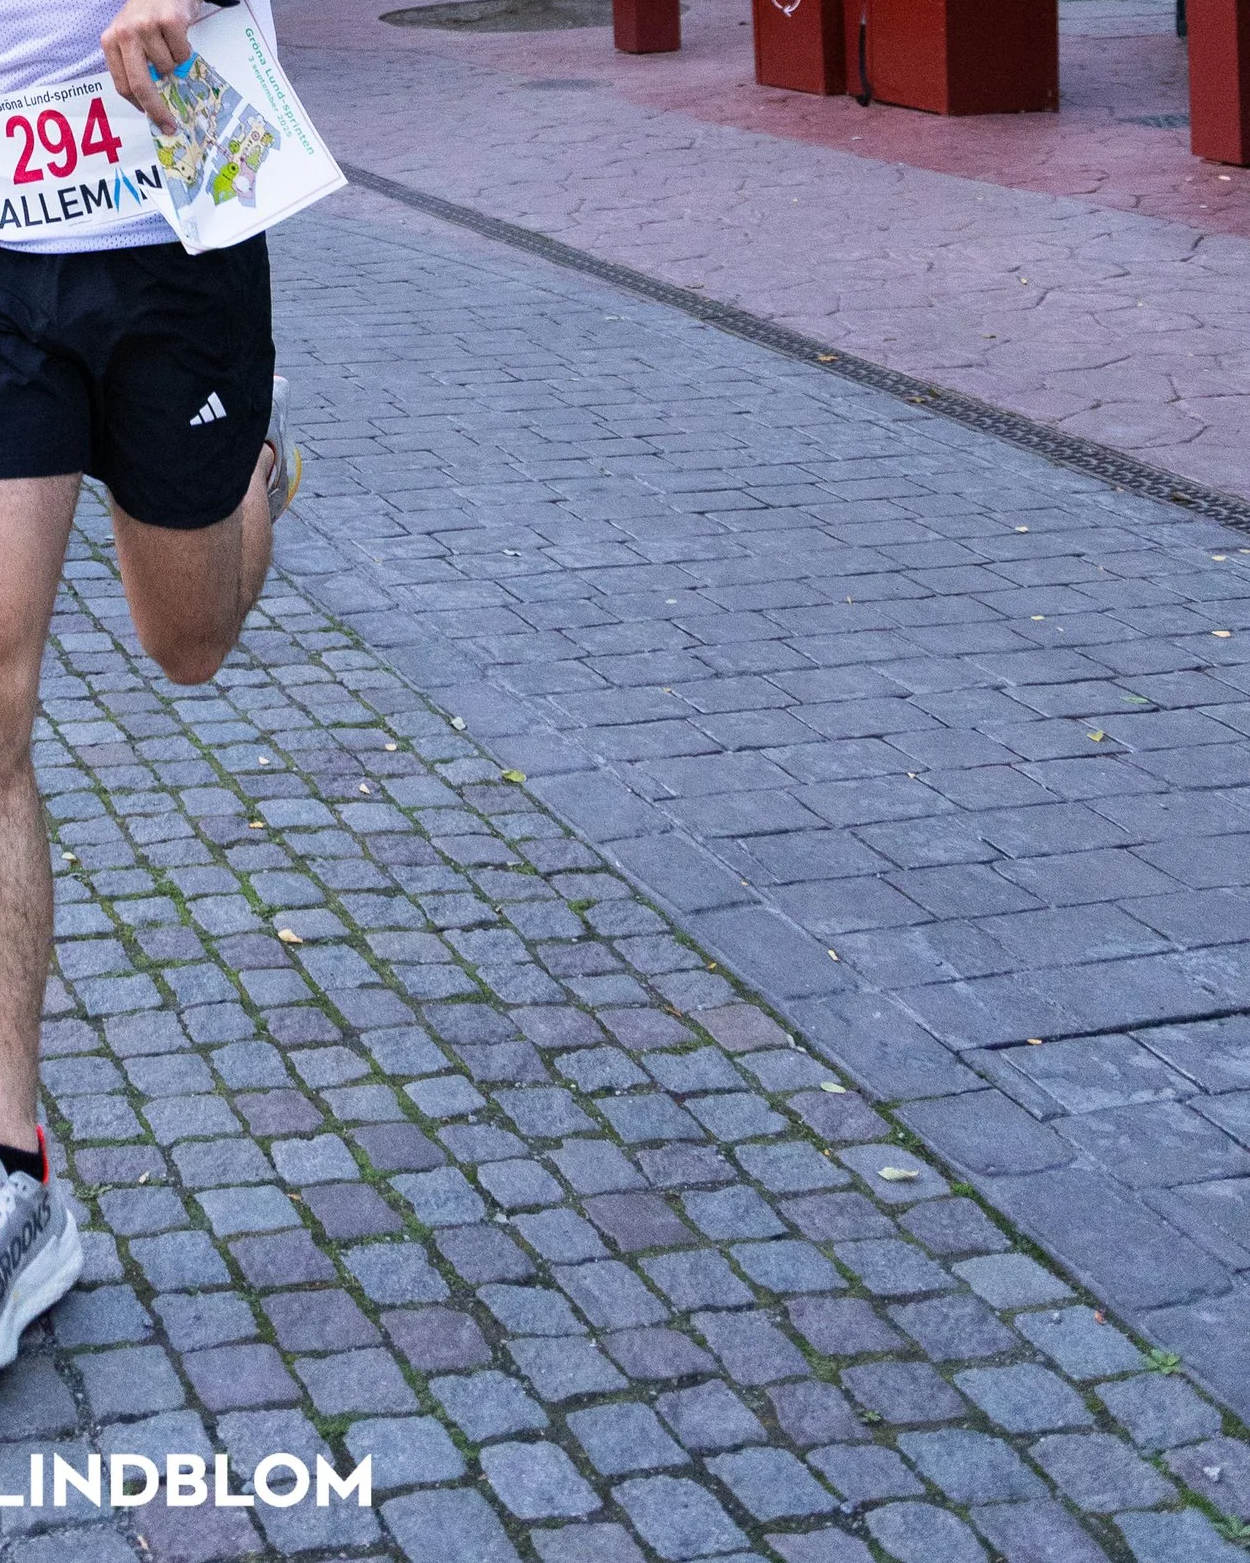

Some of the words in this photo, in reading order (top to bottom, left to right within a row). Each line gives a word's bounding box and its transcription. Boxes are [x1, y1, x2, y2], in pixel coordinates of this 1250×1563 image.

[24, 81, 103, 107] Lund-sprinten
[245, 27, 267, 66] Gröna
[265, 68, 315, 156] Lund-sprinten
[248, 54, 256, 63] 3
[252, 64, 279, 113] september
[276, 113, 293, 139] 2025
[5, 97, 123, 185] 294
